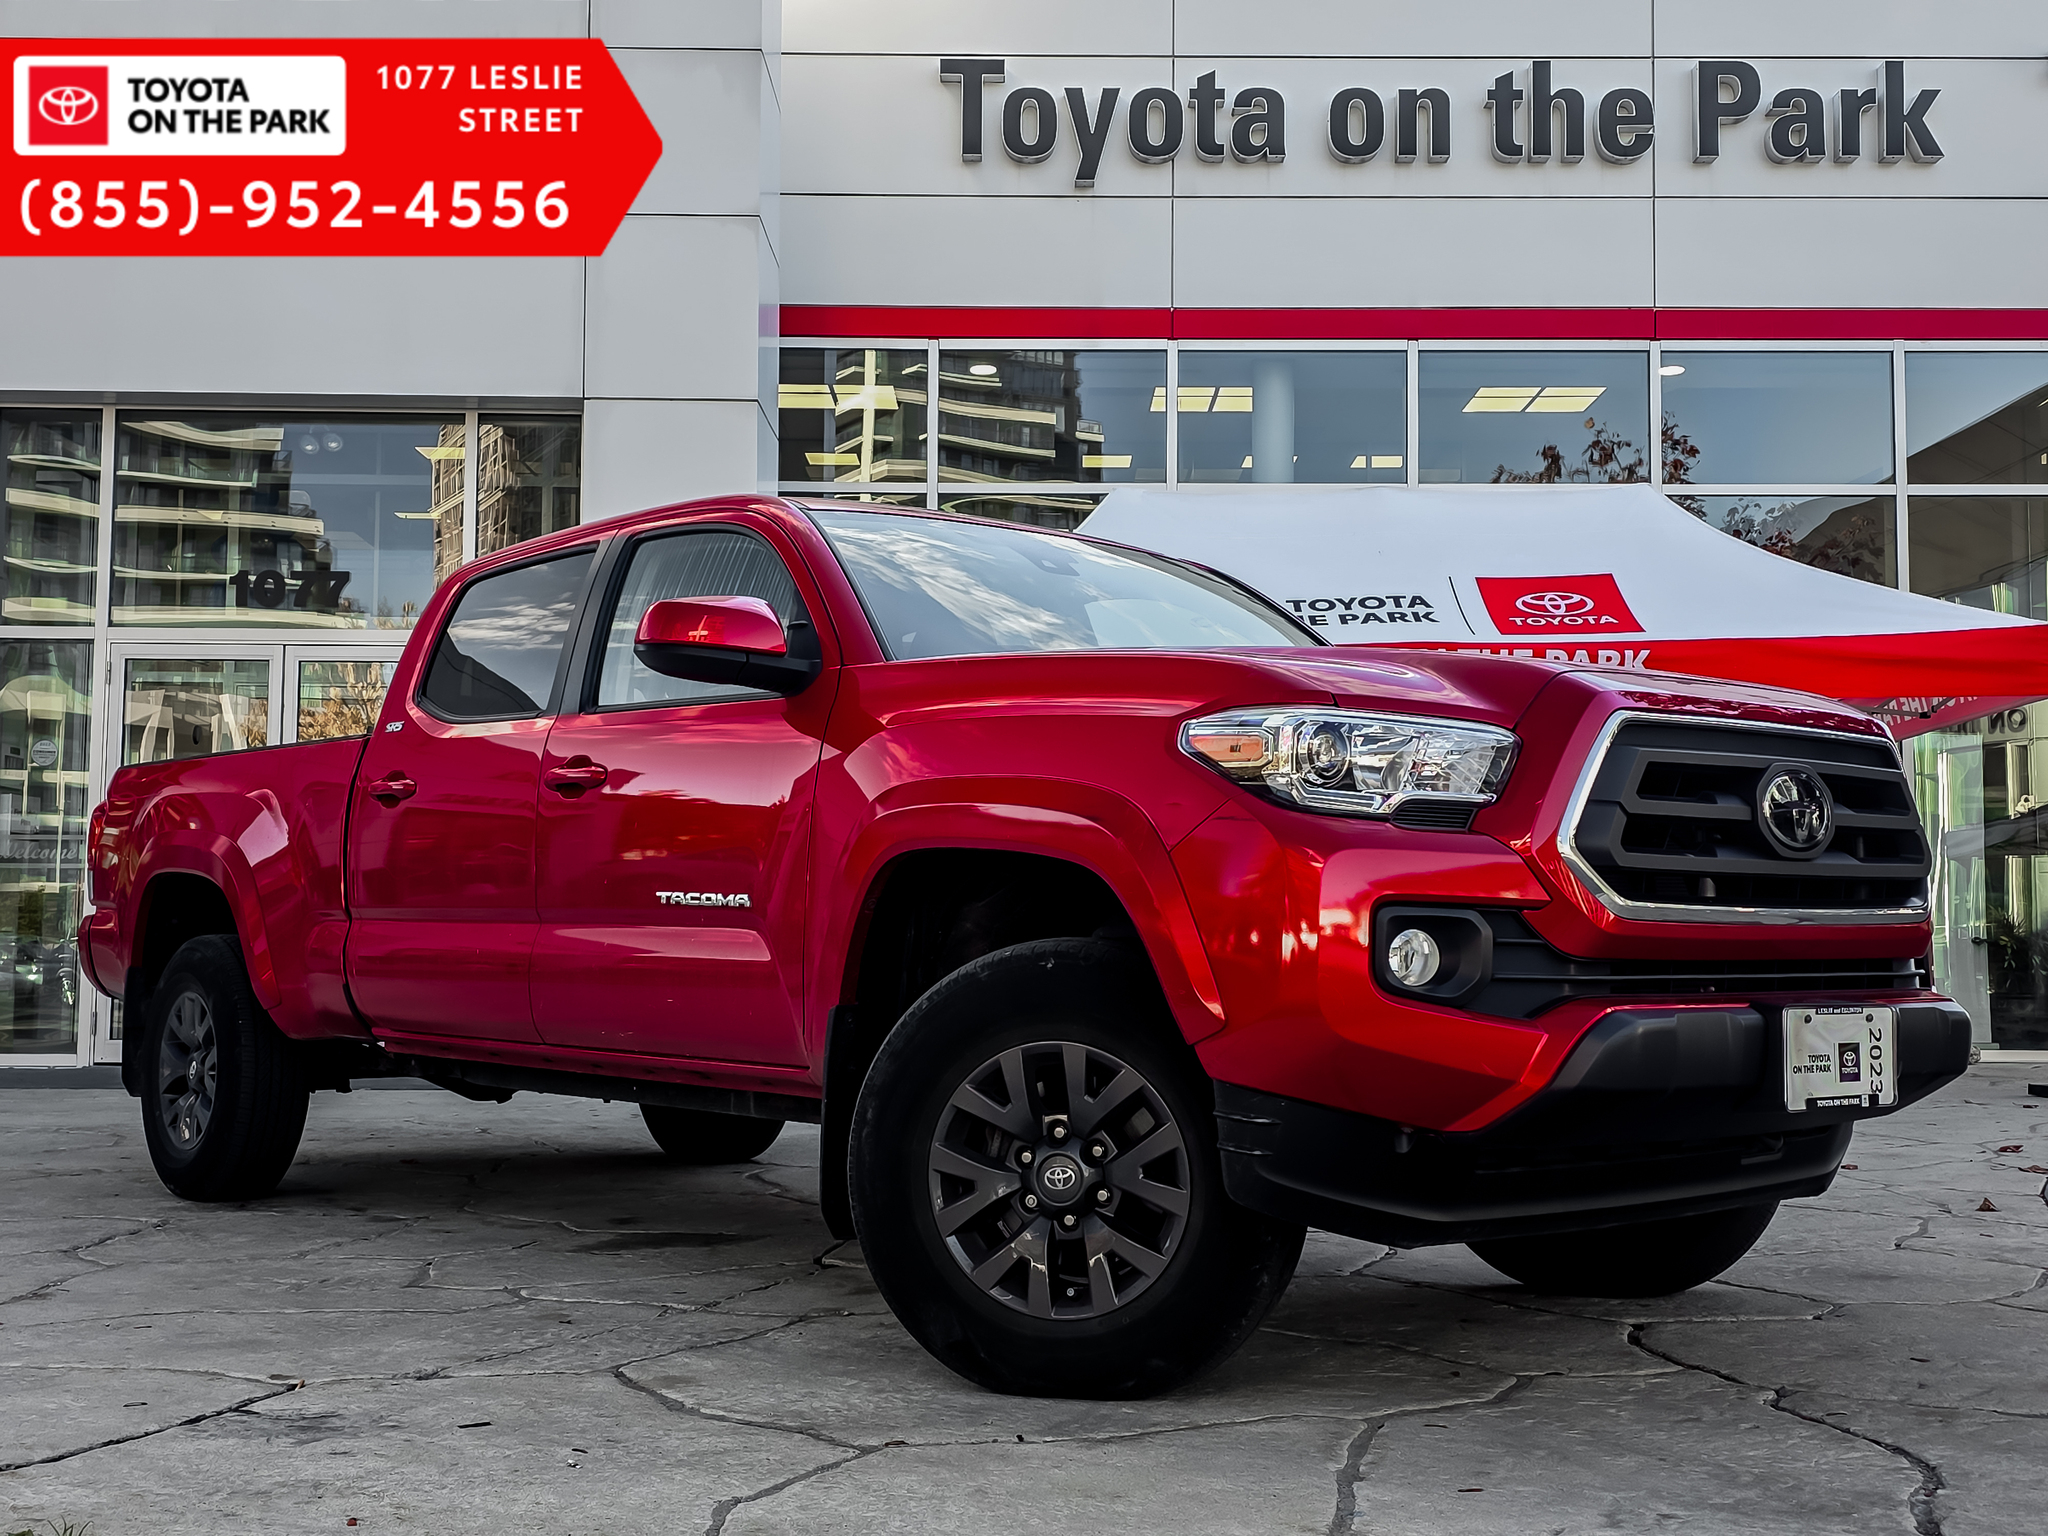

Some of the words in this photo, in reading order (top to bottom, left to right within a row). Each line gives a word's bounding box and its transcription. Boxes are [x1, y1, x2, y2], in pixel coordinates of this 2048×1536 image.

[939, 58, 1288, 188] Toyota
[1328, 86, 1453, 165] on
[1485, 60, 1656, 166] the
[1692, 60, 1945, 166] Park
[229, 569, 352, 608] 1077
[1285, 595, 1435, 613] TOYOTA
[1337, 611, 1441, 625] PARK
[1508, 614, 1620, 627] TOYOTA
[656, 891, 752, 907] TACOMA
[1807, 1054, 1831, 1063] TOYOTA
[1869, 1027, 1883, 1094] 2023
[1792, 1065, 1803, 1074] ON
[1803, 1065, 1815, 1074] THE
[1815, 1064, 1832, 1073] PARK
